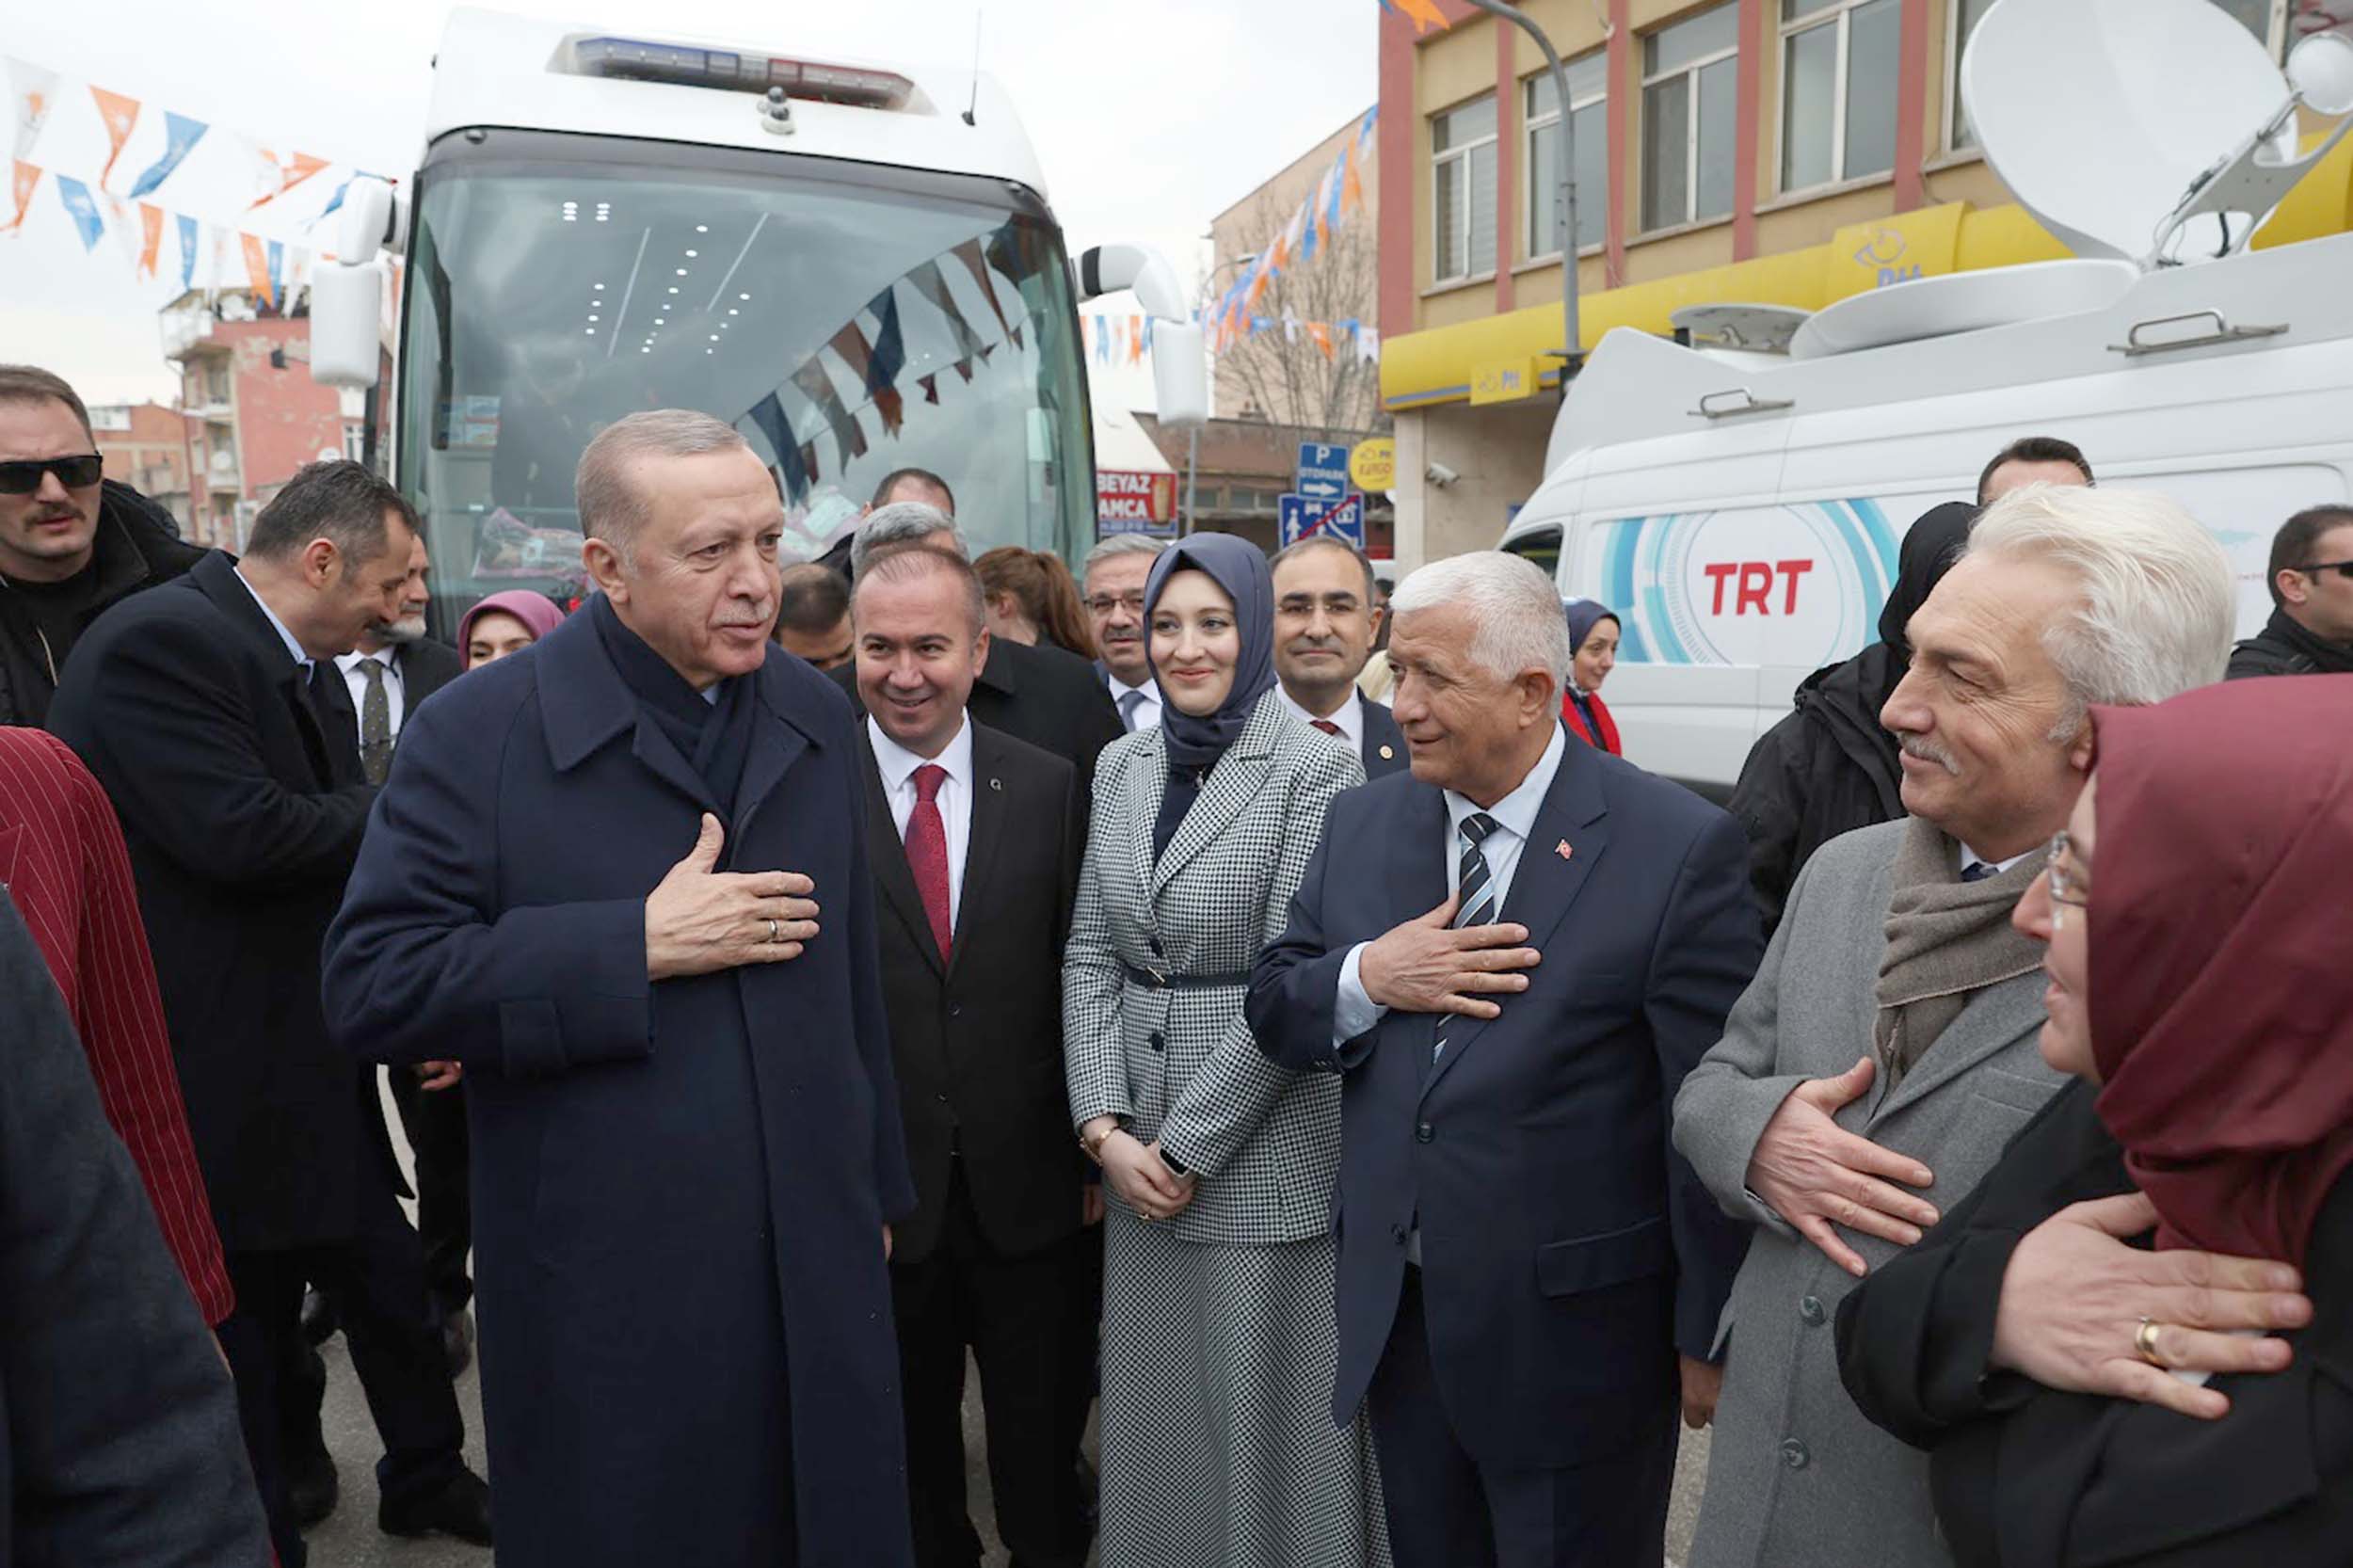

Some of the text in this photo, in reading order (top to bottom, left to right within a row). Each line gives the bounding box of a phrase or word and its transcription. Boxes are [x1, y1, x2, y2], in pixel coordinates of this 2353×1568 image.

[1316, 446, 1330, 464] P
[1097, 473, 1150, 494] BEYAZ
[1098, 498, 1147, 519] AMCA
[1705, 559, 1814, 616] TRT
